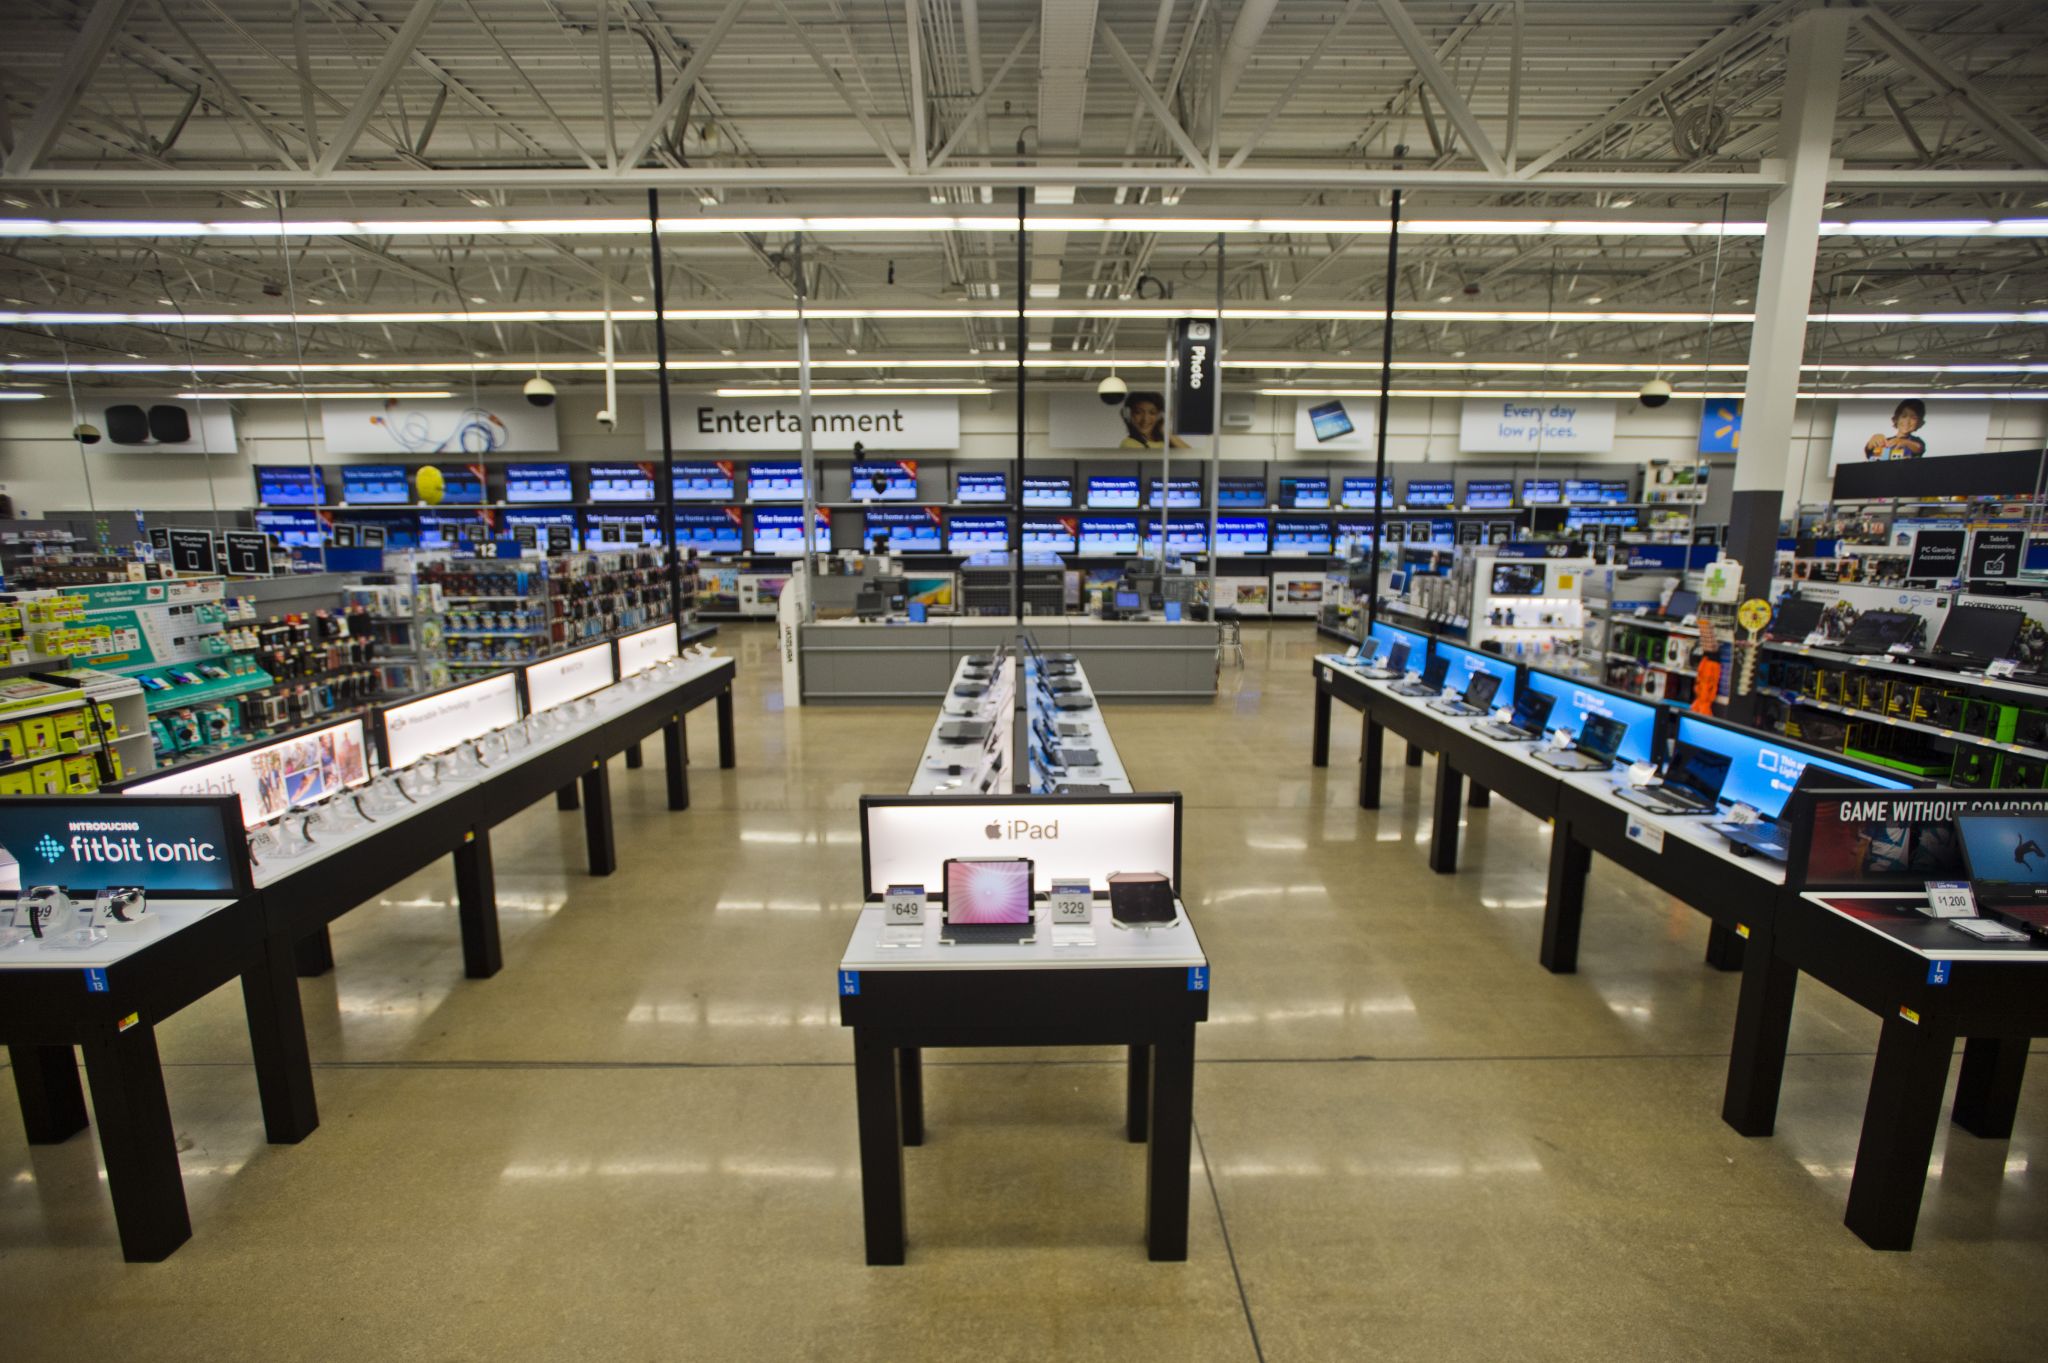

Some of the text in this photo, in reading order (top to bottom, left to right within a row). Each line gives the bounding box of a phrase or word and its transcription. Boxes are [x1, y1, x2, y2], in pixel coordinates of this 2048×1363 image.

[1190, 345, 1205, 389] Photo
[697, 406, 904, 433] Entertanment
[1503, 403, 1576, 422] Every day
[1498, 423, 1523, 438] low
[1931, 546, 1956, 554] Gaming
[180, 774, 236, 795] tbit
[1840, 800, 1887, 822] GAME
[68, 822, 140, 831] INTRODUCING
[1007, 820, 1059, 840] iPad
[70, 836, 144, 862] fitbit
[892, 902, 918, 916] $649
[1058, 901, 1084, 914] $329
[1195, 967, 1203, 979] L
[1936, 960, 1944, 972] L
[90, 968, 100, 981] L
[844, 972, 854, 984] L
